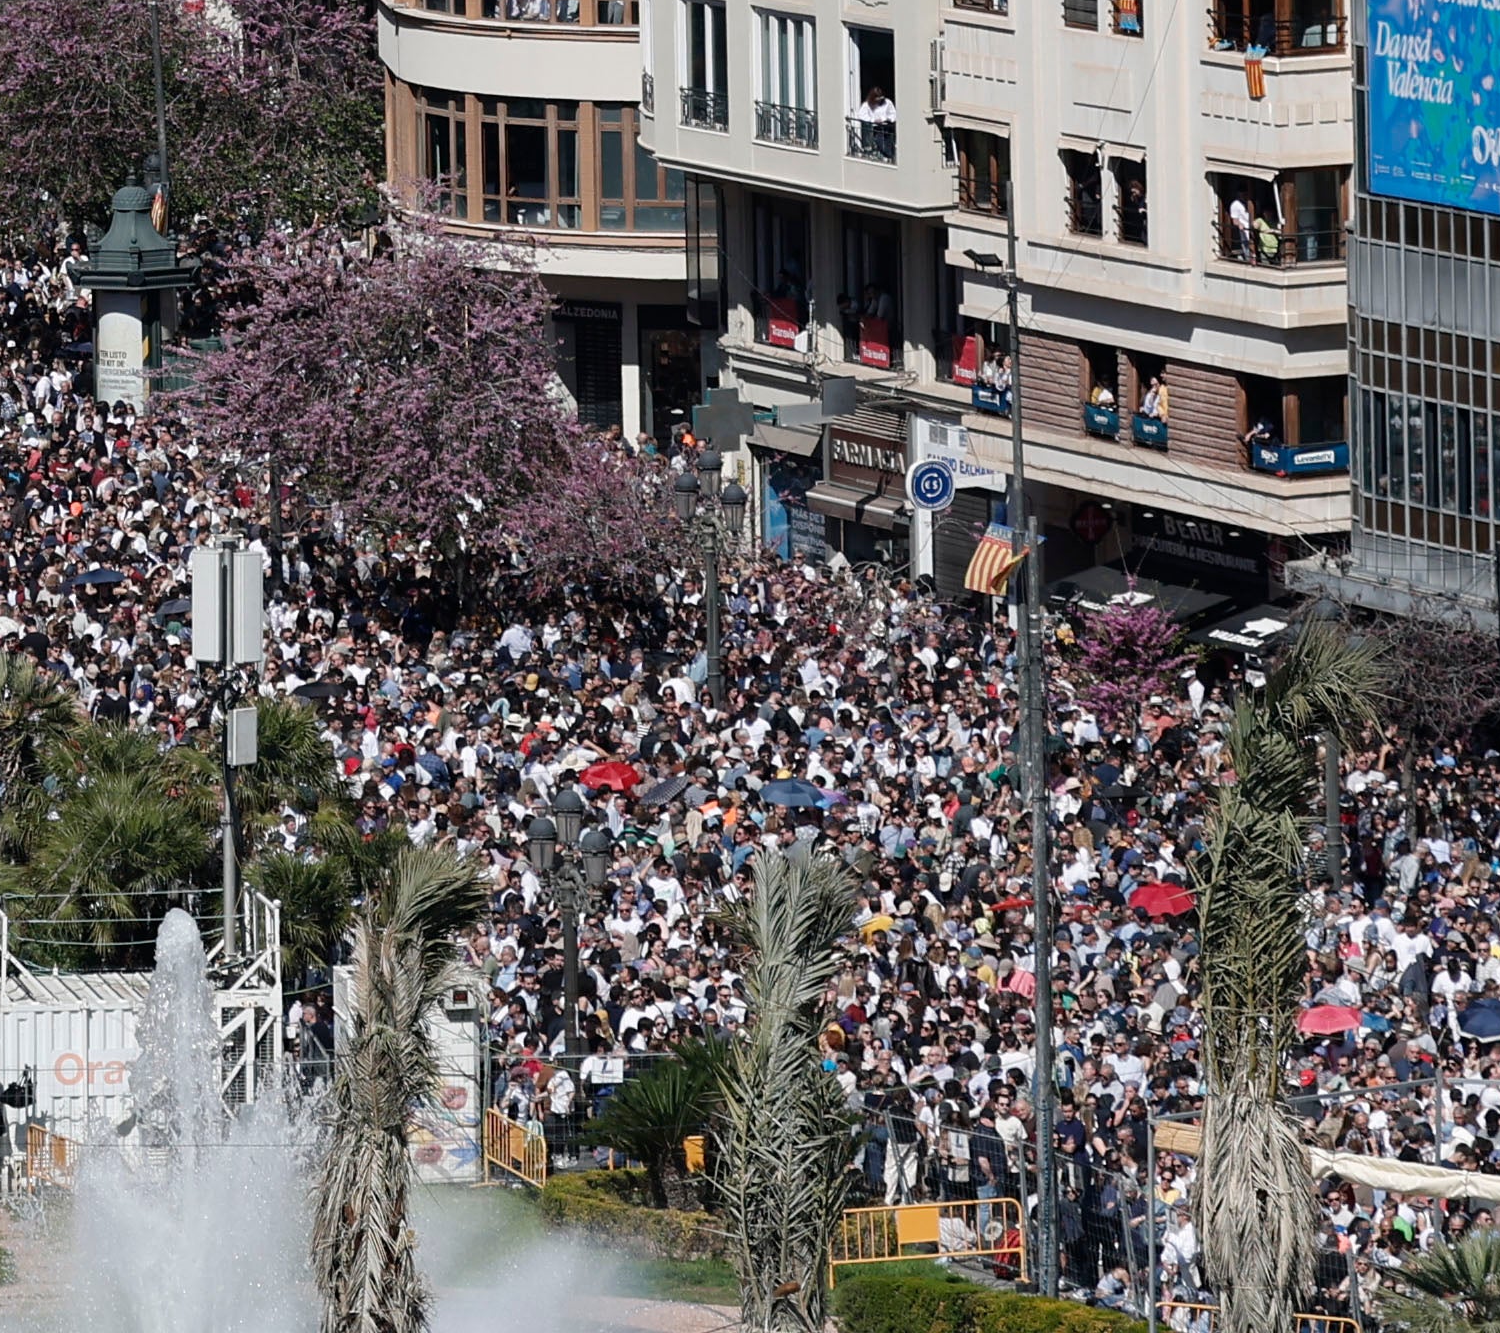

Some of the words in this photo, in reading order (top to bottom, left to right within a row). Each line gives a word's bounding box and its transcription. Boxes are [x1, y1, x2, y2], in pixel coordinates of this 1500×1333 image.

[1376, 21, 1433, 63] Dansa
[1387, 61, 1454, 105] València
[833, 438, 907, 475] FARMACIA
[54, 1052, 126, 1086] Ora
